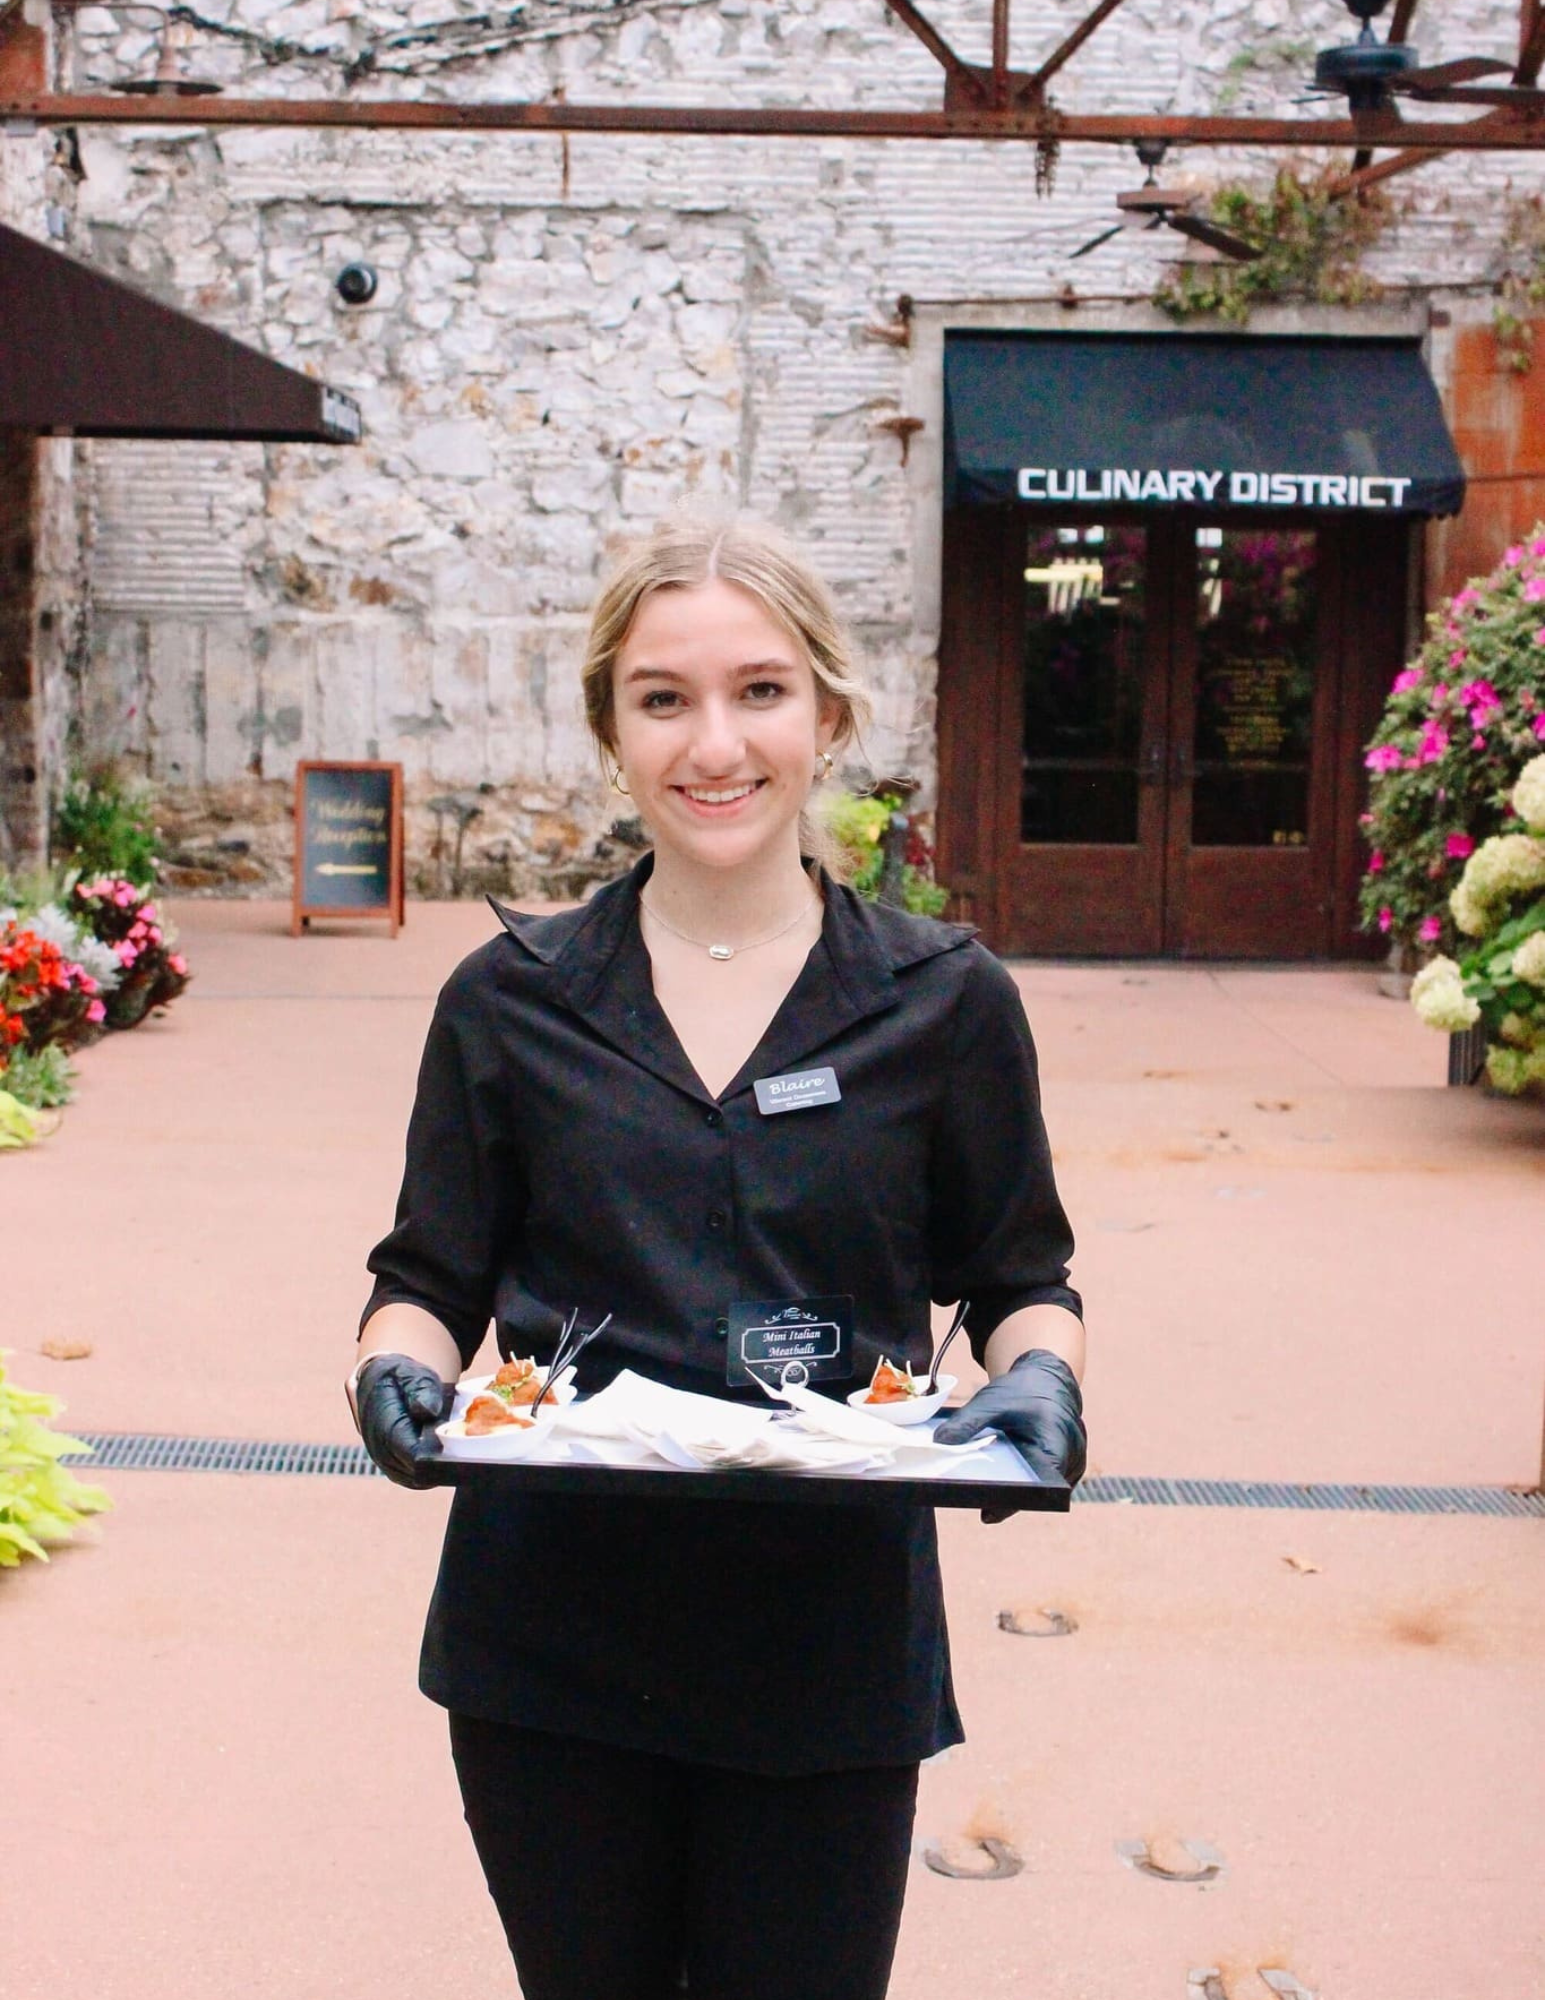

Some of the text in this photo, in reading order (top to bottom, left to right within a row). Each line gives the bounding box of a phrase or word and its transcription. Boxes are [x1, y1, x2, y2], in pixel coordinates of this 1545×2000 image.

[1018, 468, 1411, 507] CULINARY DISTRICT
[769, 1077, 826, 1095] Blaire
[762, 1328, 821, 1343] Mini Italian
[768, 1343, 815, 1357] Meatballs
